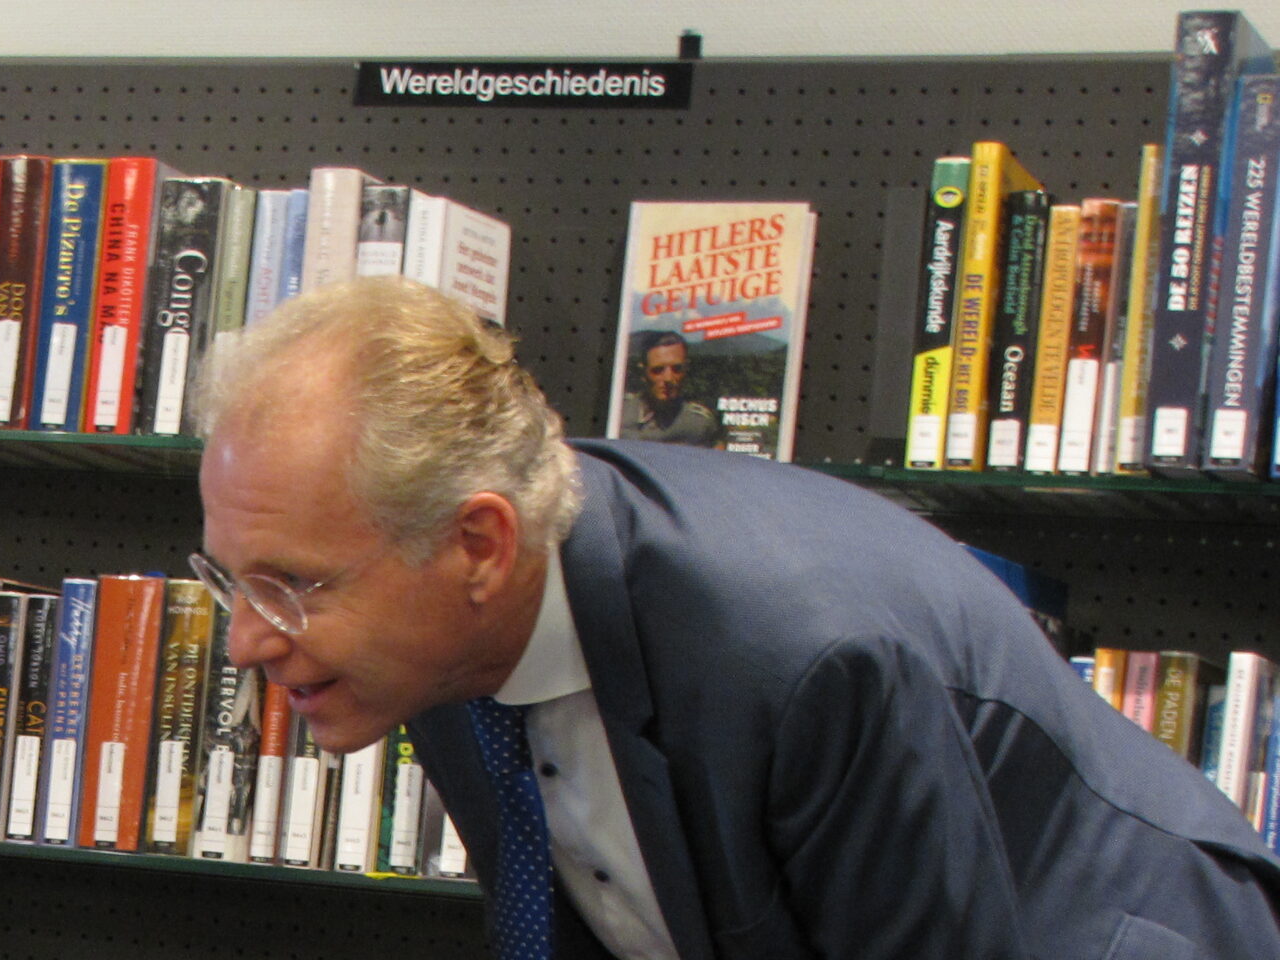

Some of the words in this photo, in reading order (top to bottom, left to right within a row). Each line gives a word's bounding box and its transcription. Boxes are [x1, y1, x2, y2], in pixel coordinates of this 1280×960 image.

[380, 66, 666, 101] Wereldgeschiedenis
[1245, 154, 1267, 188] 225
[63, 181, 86, 212] De
[1172, 163, 1200, 245] REIZEN
[105, 203, 125, 263] CHINA
[123, 223, 137, 262] FRANK
[649, 213, 785, 261] HITLERS
[1022, 214, 1038, 249] David
[52, 215, 84, 318] Pizarro's
[103, 272, 118, 296] NA
[649, 243, 781, 288] LAATSTE
[923, 219, 954, 335] Aardrijkskunde
[963, 272, 983, 291] DE
[1046, 216, 1075, 340] ANTROPOLOGEN
[1168, 245, 1191, 278] 50
[117, 266, 135, 325] DIKÖTTER
[640, 270, 783, 316] GETUIGE
[1011, 252, 1035, 335] Attenborough
[1166, 279, 1188, 312] DE
[1222, 190, 1261, 406] WERELDBESTEMMINGEN
[918, 356, 939, 414] dummie
[998, 343, 1025, 412] Oceaan
[57, 596, 91, 652] Harry
[164, 639, 181, 675] VAN
[185, 642, 199, 664] DE
[1164, 665, 1181, 687] DE
[54, 690, 67, 733] PRINS
[215, 664, 238, 737] EERVOL
[1157, 689, 1179, 740] PADEN
